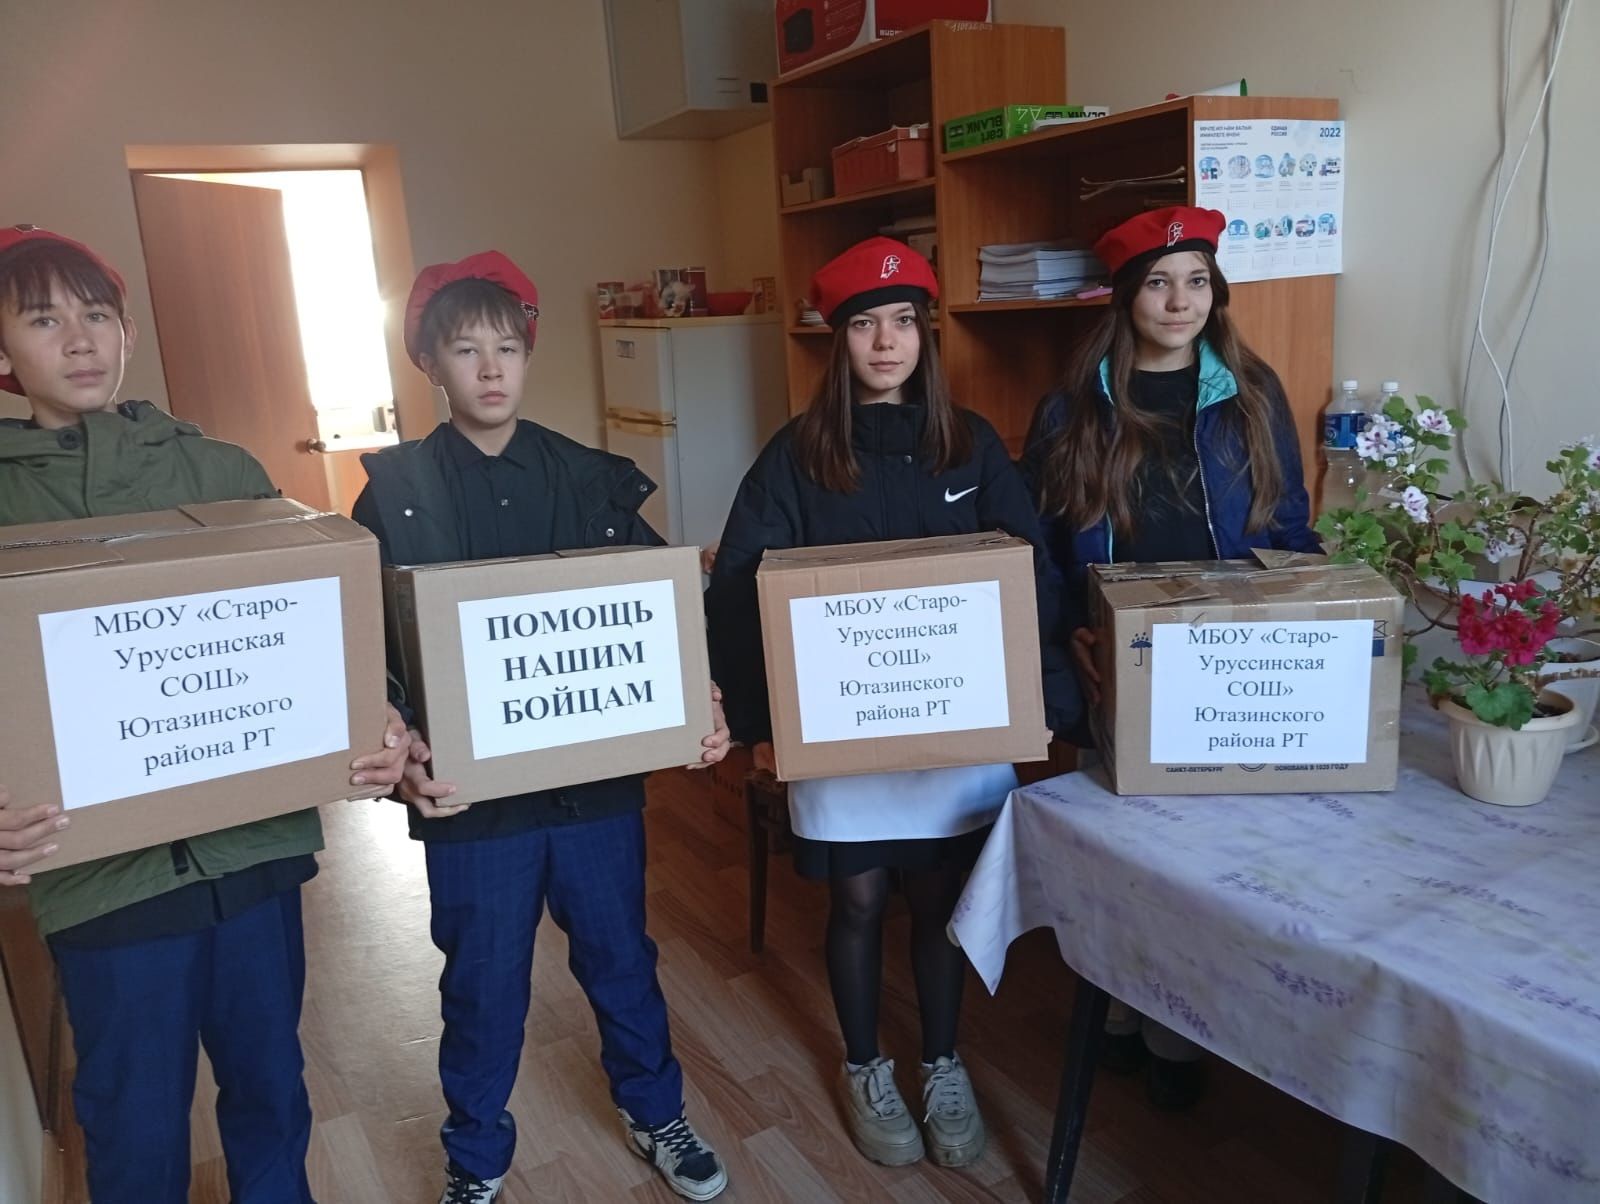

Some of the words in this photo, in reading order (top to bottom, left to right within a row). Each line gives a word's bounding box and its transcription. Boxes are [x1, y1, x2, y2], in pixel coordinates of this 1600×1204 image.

[965, 115, 1002, 135] BLANK
[1015, 107, 1042, 121] A4
[1319, 127, 1341, 138] 2022
[93, 603, 188, 638] МБОУ
[196, 597, 299, 622] «Старо-
[824, 597, 887, 618] МБОУ
[893, 594, 968, 613] «Старо-
[484, 600, 654, 642] ПОМОЩЬ
[837, 622, 959, 647] Уруссинская
[1187, 628, 1255, 645] МБОУ
[1259, 627, 1339, 648] «Старо-
[113, 630, 286, 673] Уруссинская
[502, 640, 645, 682] НАШИМ
[867, 648, 932, 668] СОШ»
[1199, 655, 1325, 675] Уруссинская
[159, 667, 250, 698] СОШ»
[838, 675, 965, 697] Ютазинского
[1226, 680, 1294, 697] СОШ»
[502, 679, 656, 725] БОЙЦАМ
[856, 704, 921, 727] района
[926, 699, 952, 718] РТ
[118, 696, 293, 741] Ютазинского
[1194, 706, 1325, 723] Ютазинского
[143, 739, 235, 777] района
[242, 726, 276, 752] РТ
[1207, 732, 1275, 752] района
[1281, 732, 1309, 748] РТ
